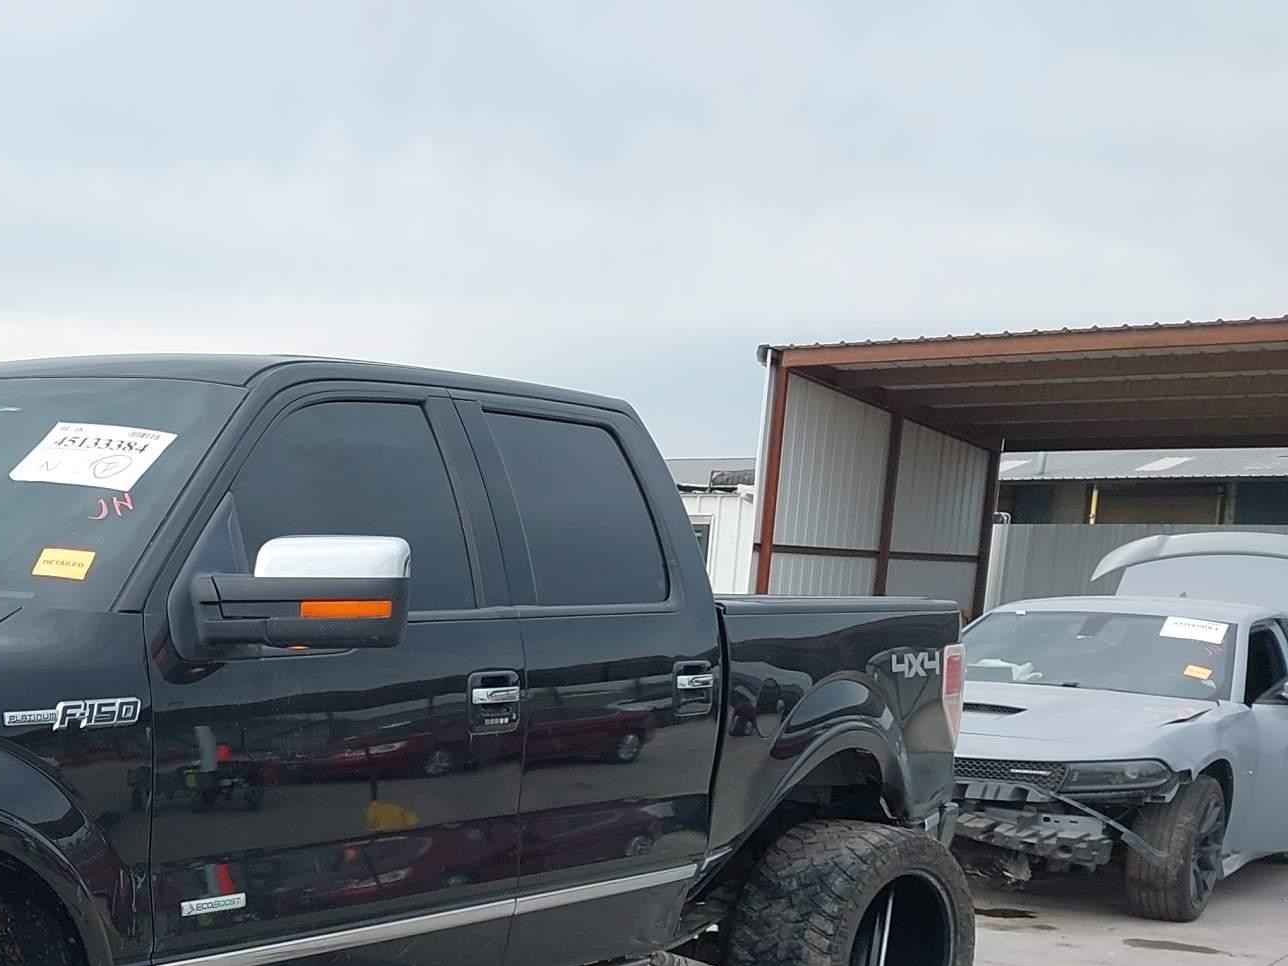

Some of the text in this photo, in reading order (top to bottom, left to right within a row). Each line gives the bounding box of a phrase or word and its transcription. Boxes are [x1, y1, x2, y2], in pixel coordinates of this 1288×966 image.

[54, 434, 151, 455] 45133384
[42, 559, 85, 568] DETAILED
[7, 711, 58, 724] PLATINUM
